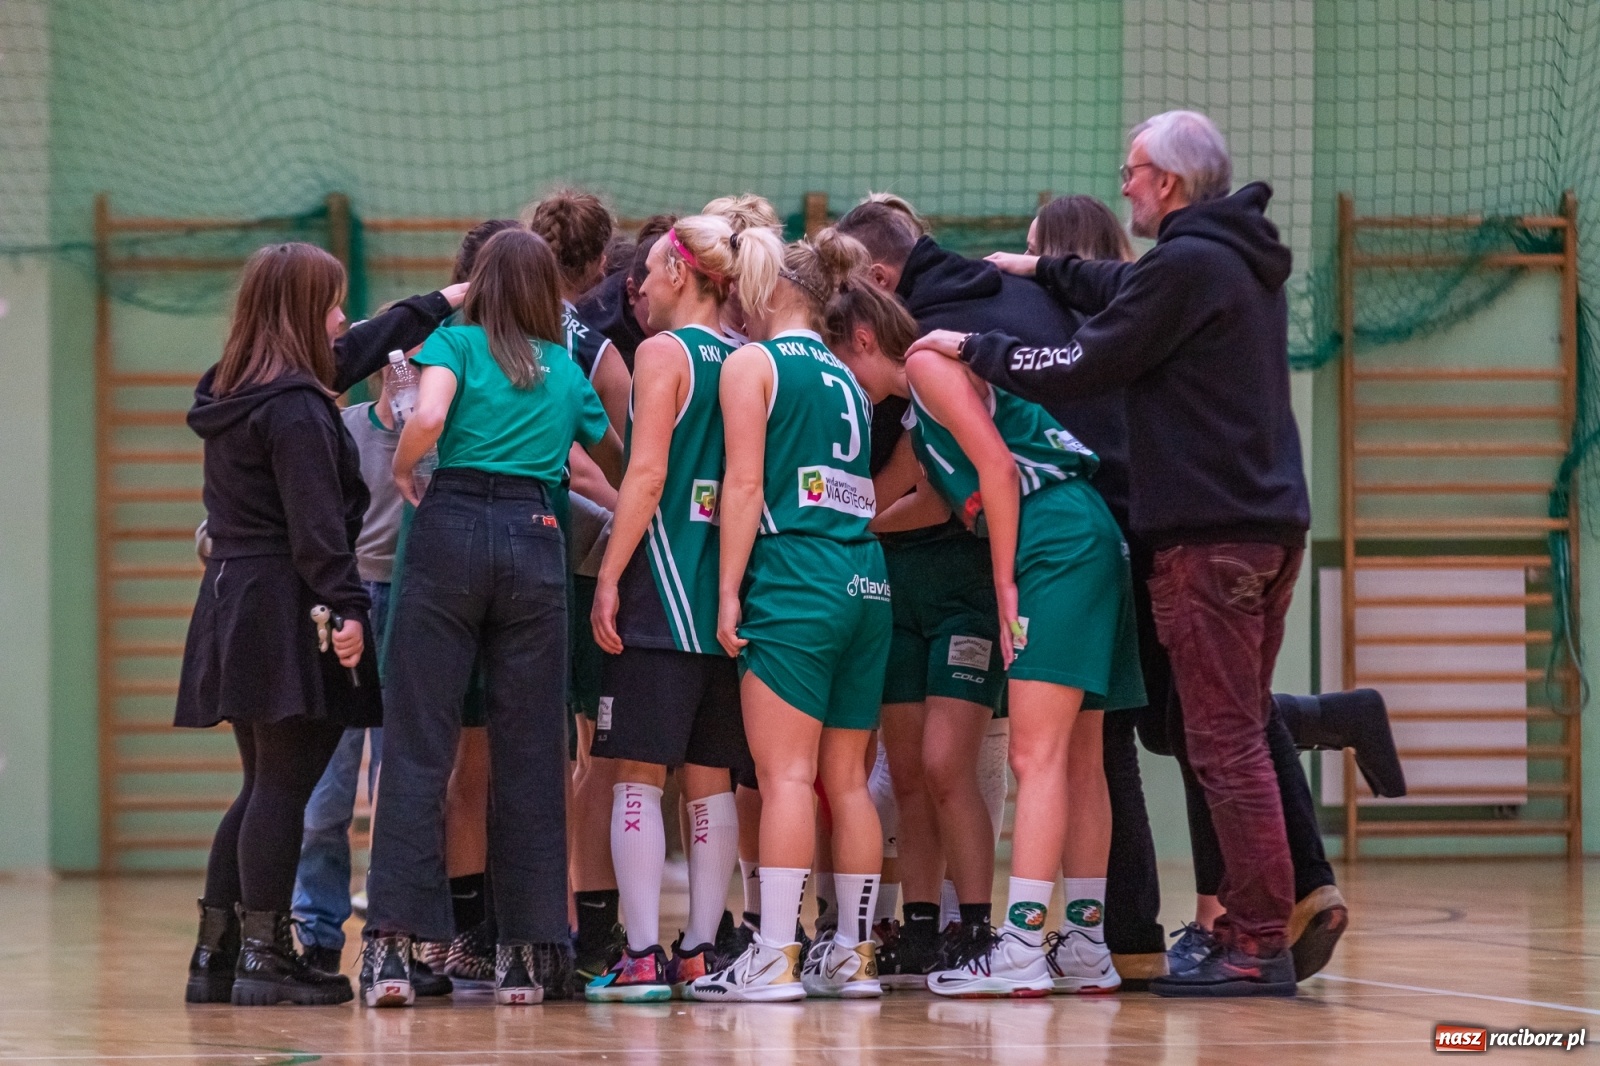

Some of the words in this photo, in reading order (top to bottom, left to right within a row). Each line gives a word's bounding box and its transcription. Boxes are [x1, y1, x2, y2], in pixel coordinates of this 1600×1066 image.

[776, 341, 810, 357] RKK
[821, 371, 861, 463] 3
[826, 484, 875, 512] WAGTECH
[860, 576, 891, 597] Clavis
[952, 672, 985, 684] COLO
